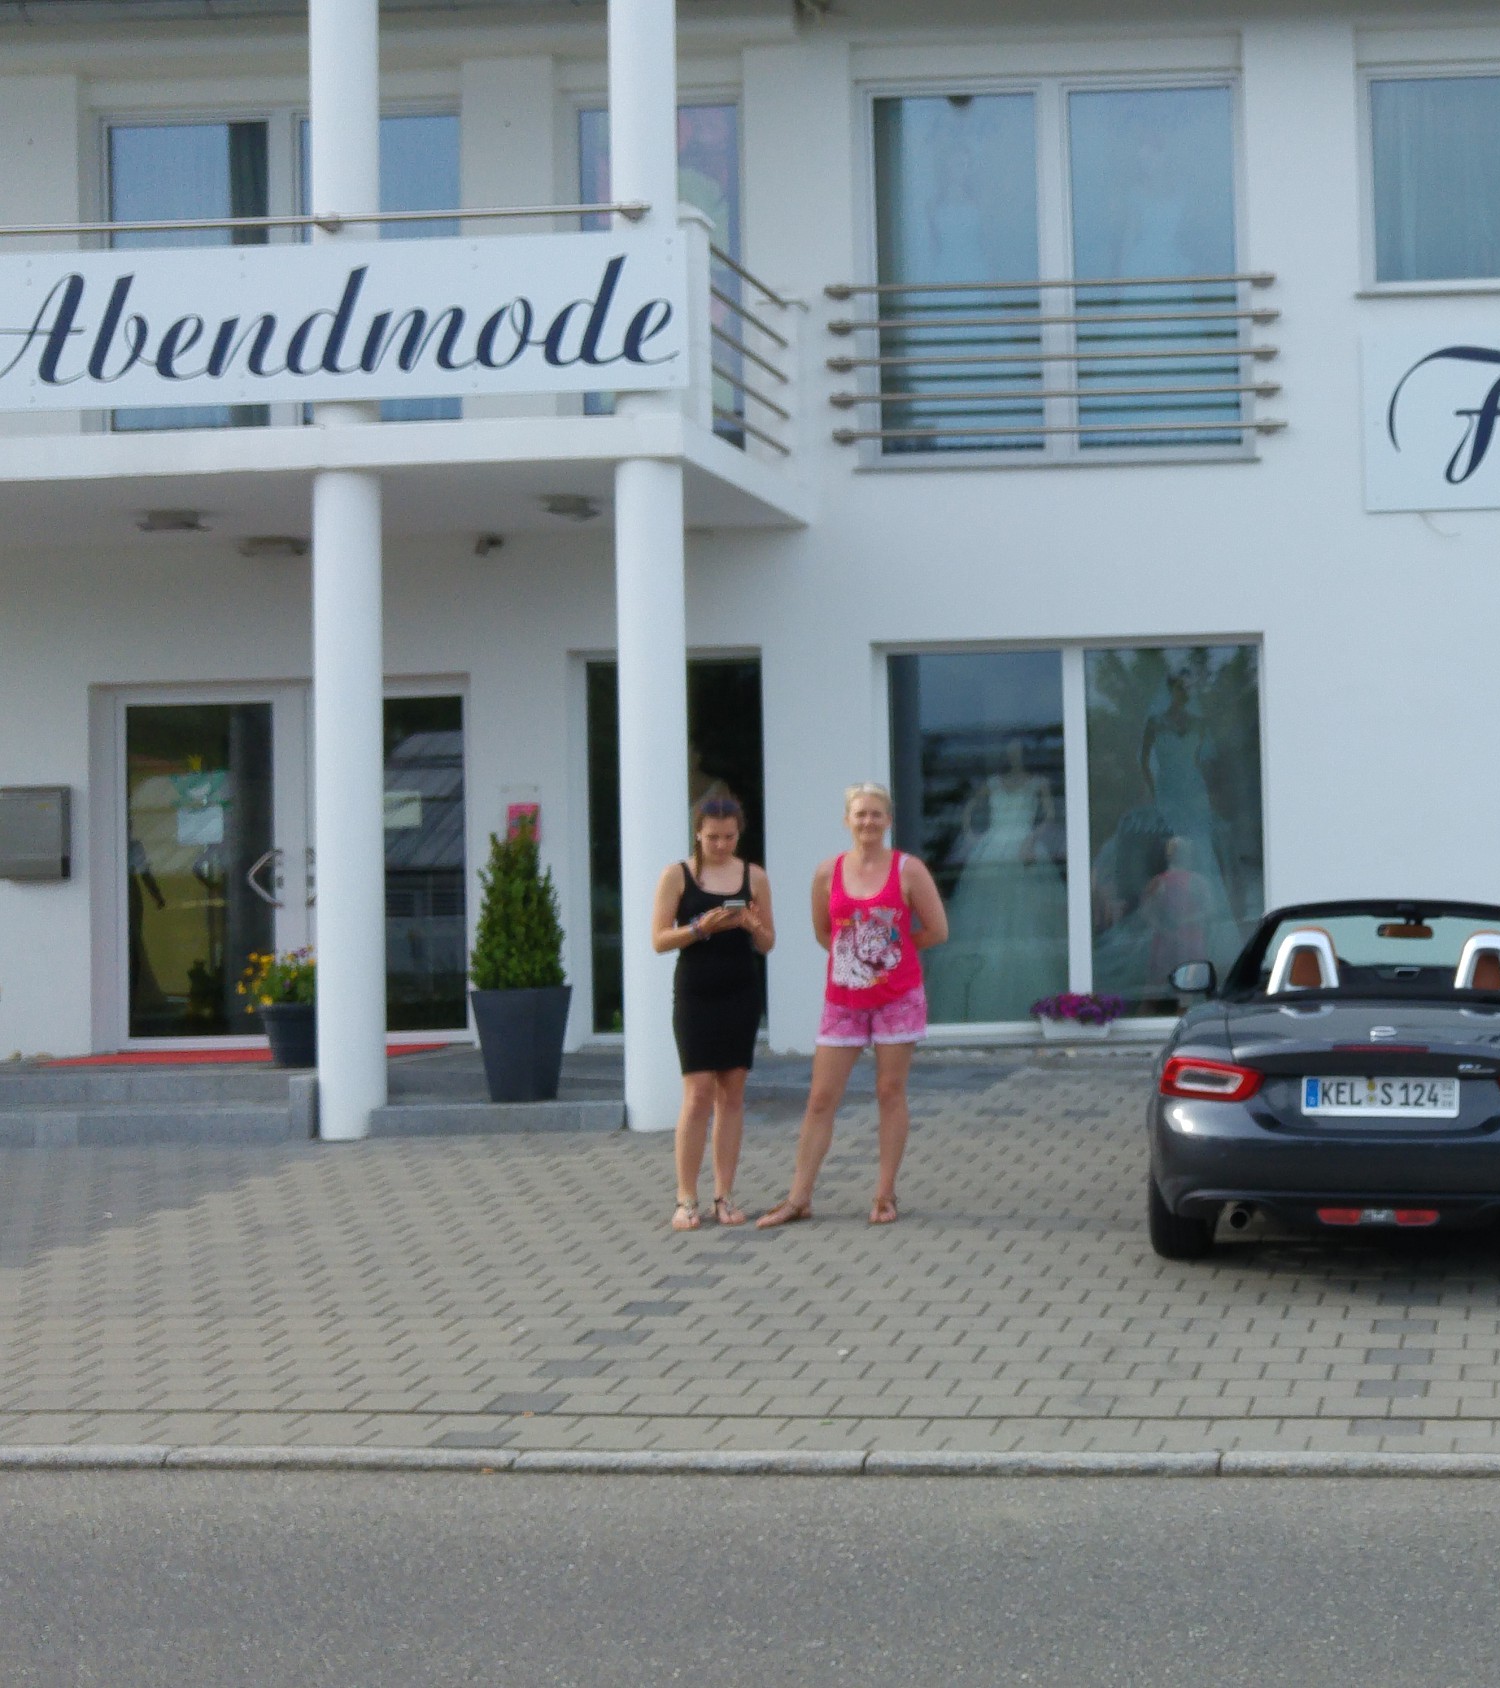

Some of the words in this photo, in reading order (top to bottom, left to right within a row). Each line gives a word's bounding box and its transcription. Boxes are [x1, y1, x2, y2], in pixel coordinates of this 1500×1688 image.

[0, 254, 680, 386] Abendmode
[1321, 1082, 1362, 1106] KEL
[1400, 1083, 1438, 1107] 124
